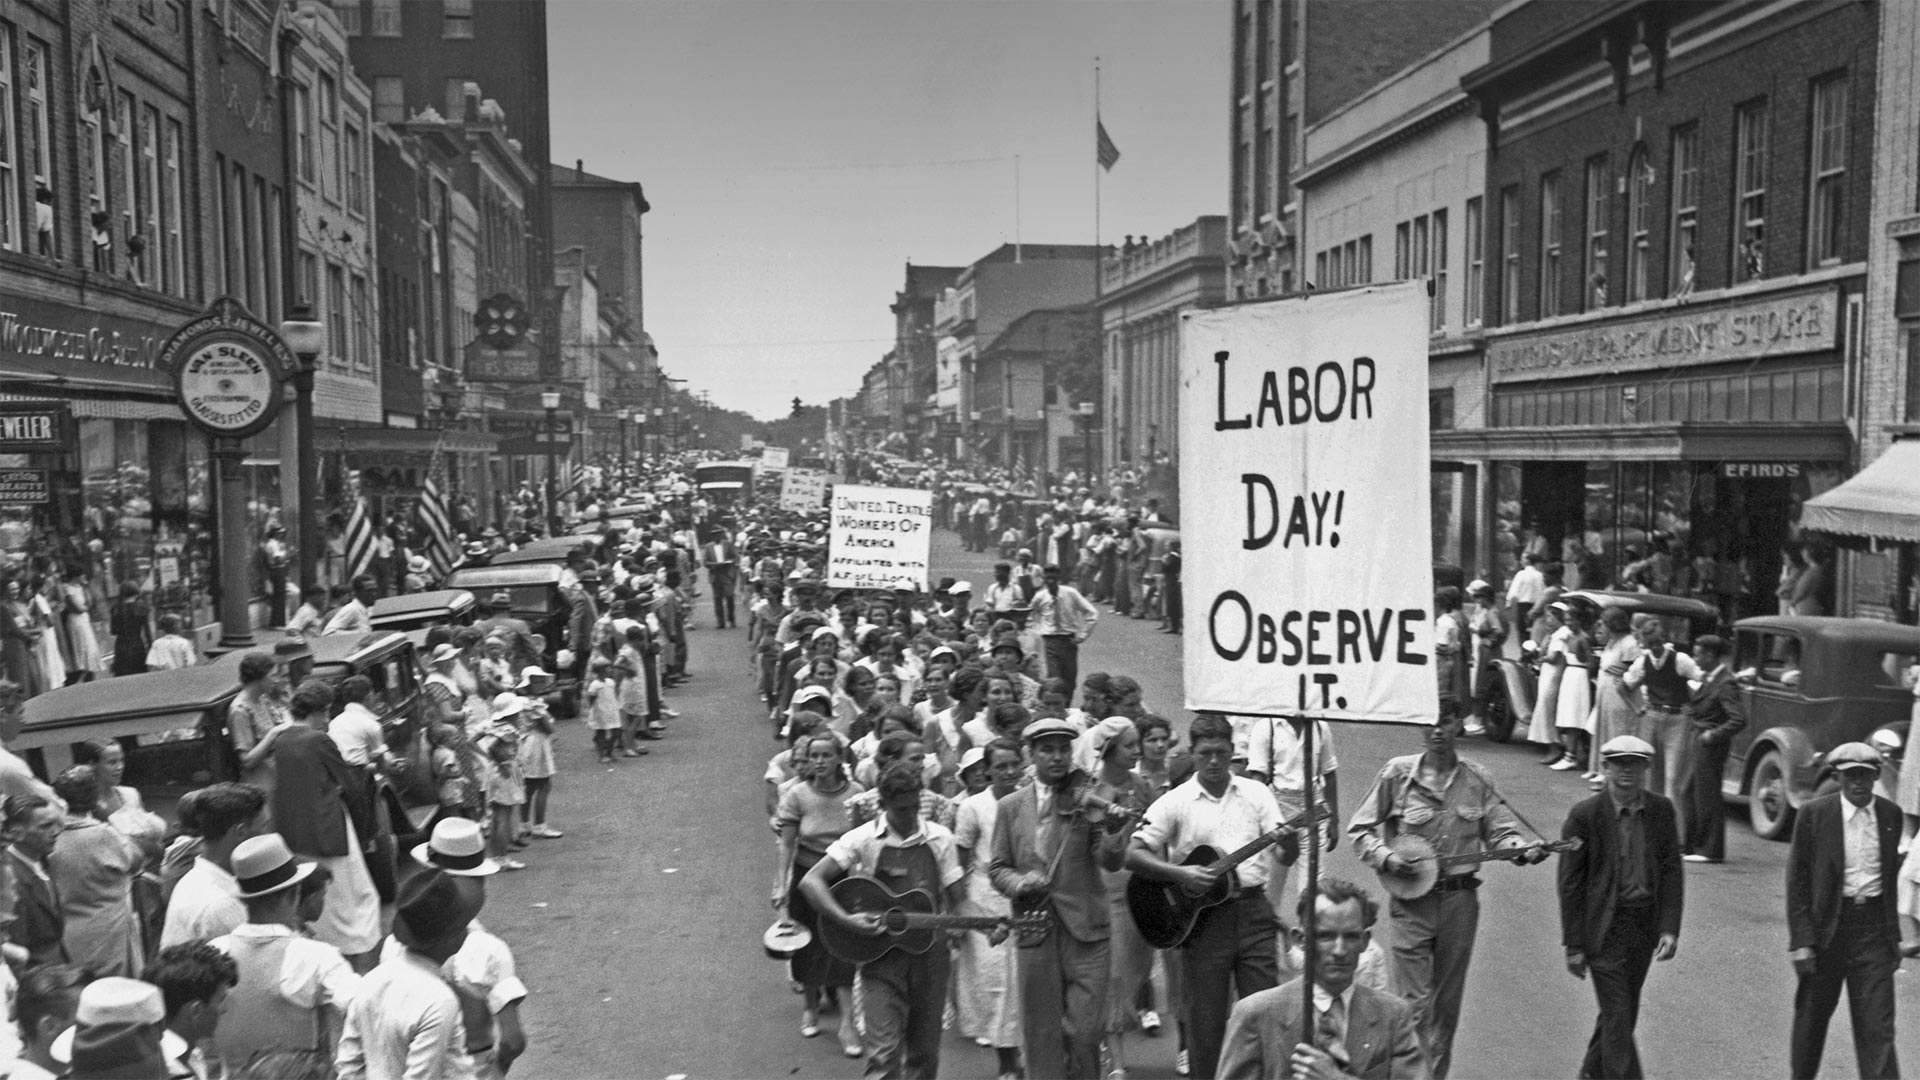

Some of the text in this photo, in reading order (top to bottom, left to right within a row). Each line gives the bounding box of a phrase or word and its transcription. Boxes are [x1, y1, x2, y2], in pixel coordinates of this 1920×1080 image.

[163, 316, 221, 361] DIAMONDS
[1566, 322, 1718, 366] DEPARTMENT
[1731, 304, 1822, 347] STORE
[189, 347, 263, 374] VAN SLEEN
[1214, 351, 1375, 431] LABOR
[191, 397, 261, 424] GLASSES FITTED
[1725, 463, 1800, 477] EFIRD'S
[837, 496, 932, 517] UNITED TEXTILE
[1241, 473, 1345, 550] DAY!
[836, 515, 921, 532] WORKERS OF
[845, 534, 895, 548] AMERICA
[832, 558, 893, 567] AFFILIATED
[1208, 589, 1428, 667] OBSERVE
[1299, 673, 1348, 711] IT.
